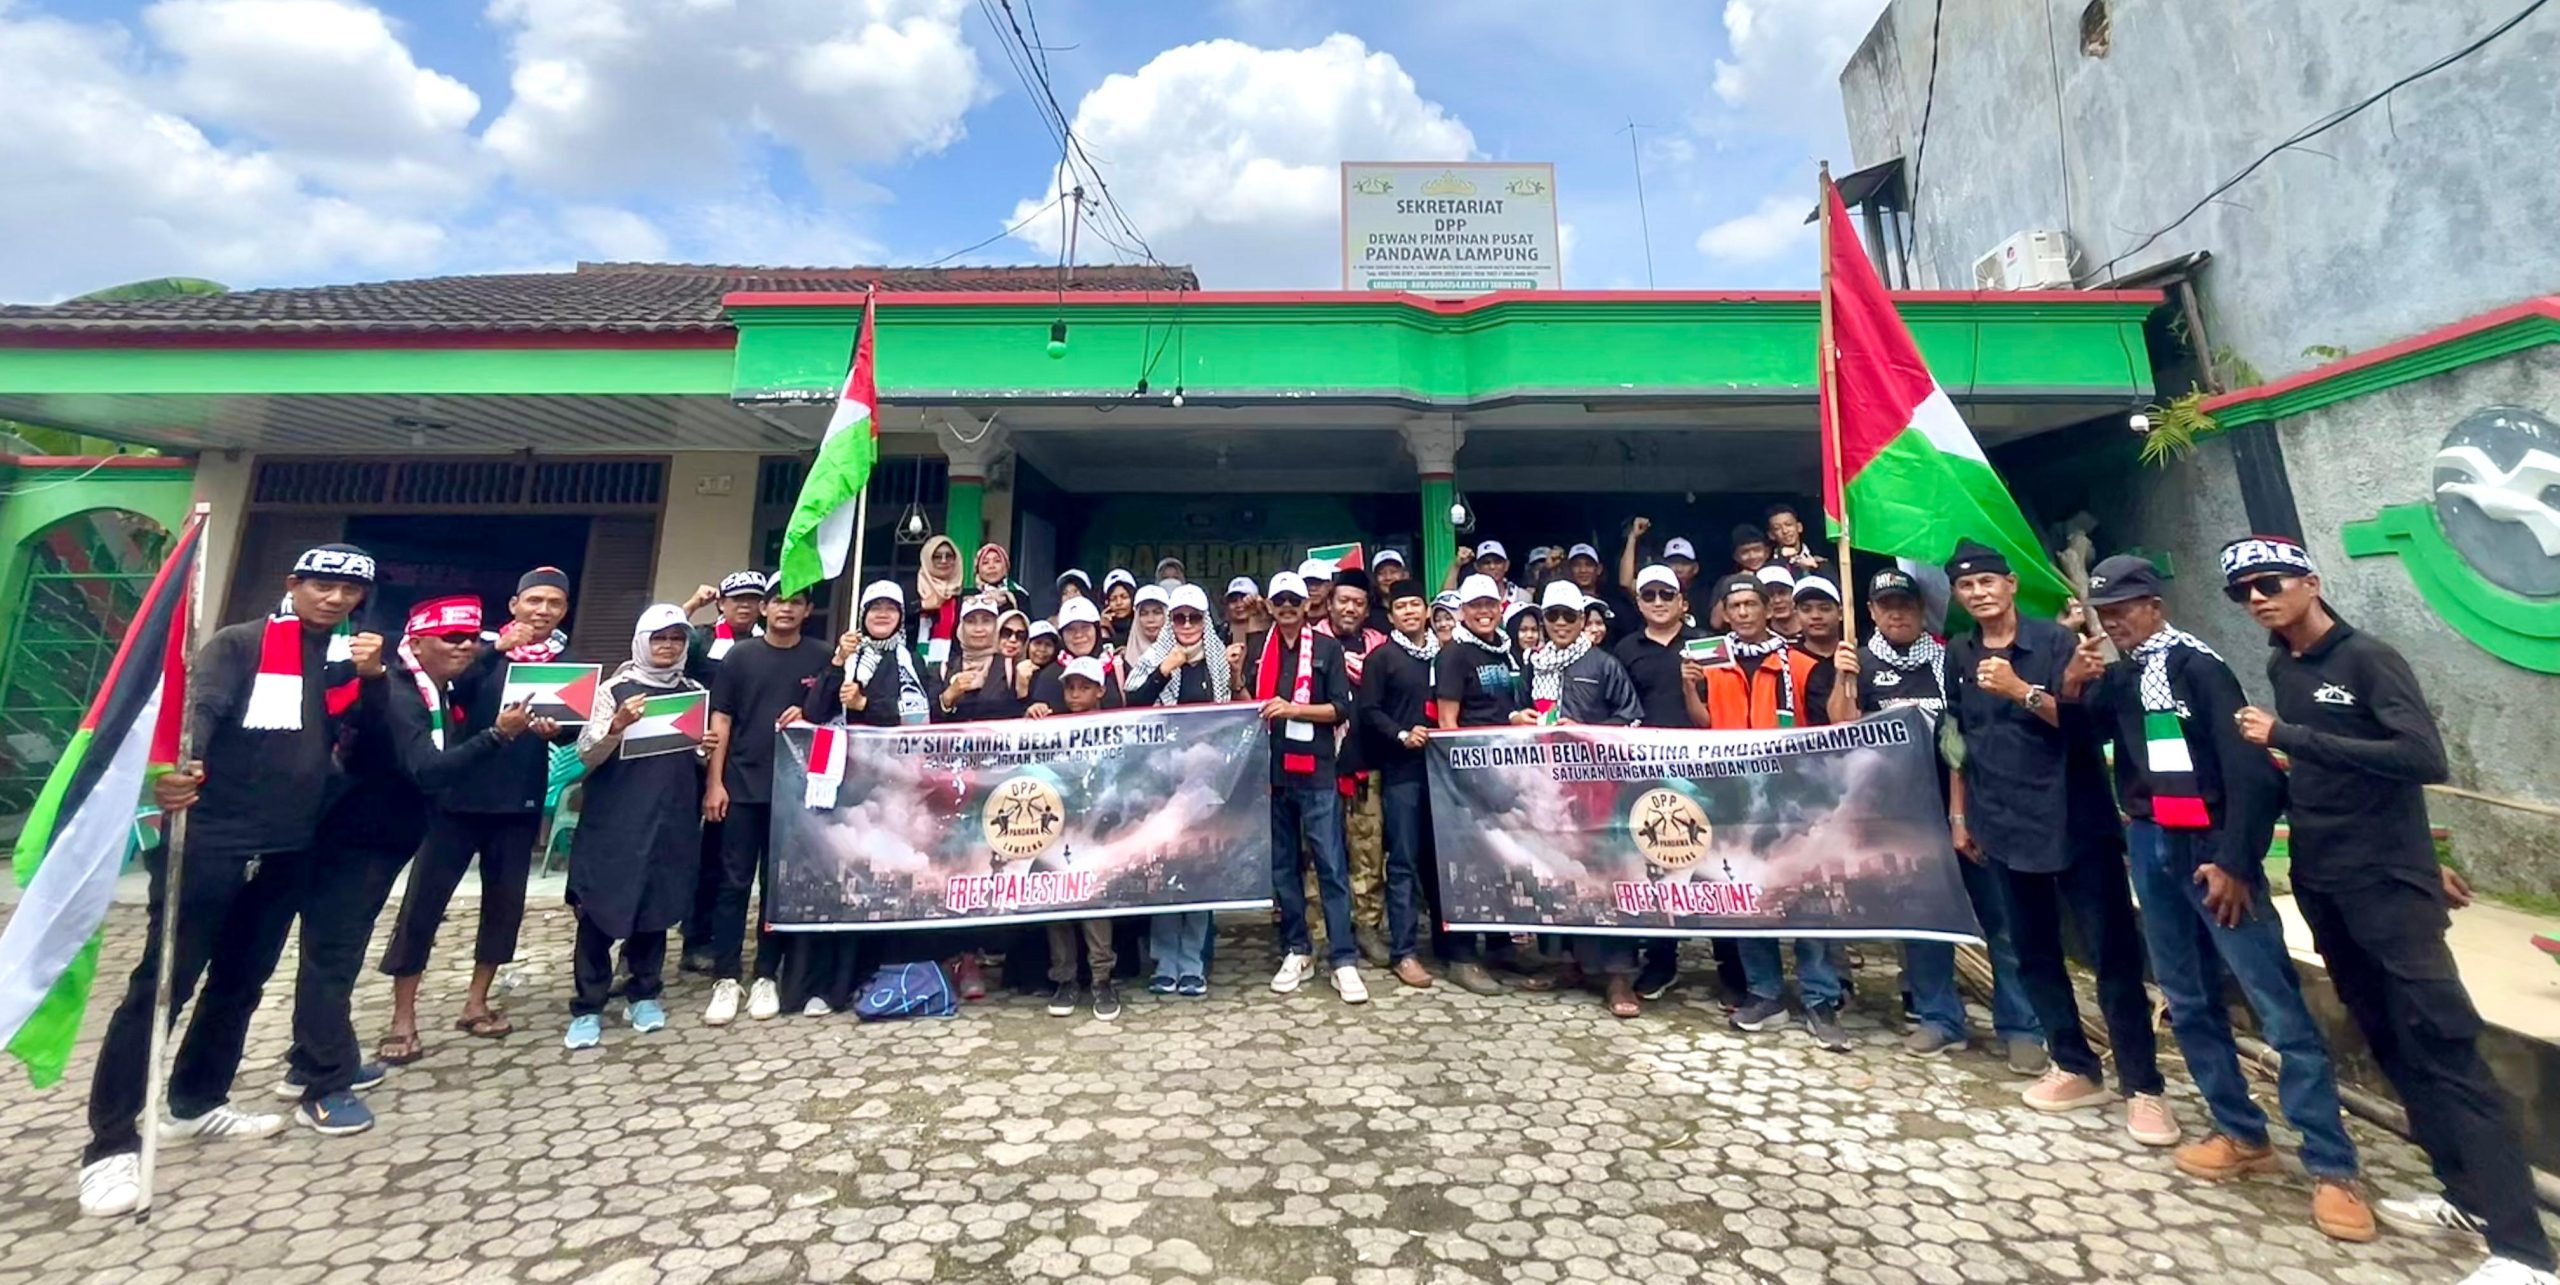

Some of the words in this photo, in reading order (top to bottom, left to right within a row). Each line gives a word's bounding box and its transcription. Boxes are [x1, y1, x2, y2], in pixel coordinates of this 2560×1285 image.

[1397, 199, 1504, 214] SEKRETARIAT
[1435, 218, 1467, 232] DPP
[1369, 233, 1418, 245] DEWAN
[1421, 233, 1489, 245] PIMPINAN
[1492, 233, 1534, 245] PUSAT
[1366, 247, 1452, 261] PANDAWA
[1456, 247, 1539, 261] LAMPUNG
[1452, 747, 1488, 767] AKSI
[1493, 745, 1546, 766] DAMAI
[1552, 743, 1591, 763] BELA
[1595, 743, 1690, 763] PALESTINA
[1698, 737, 1800, 759] PANDAWA
[1805, 721, 1908, 751] LAMPUNG
[1552, 764, 1607, 781] SATUKAN
[1717, 760, 1747, 775] DAN
[1751, 759, 1782, 773] DOA
[1011, 781, 1037, 797] DPP
[1651, 794, 1677, 808] DPP
[947, 876, 989, 911] FREE
[993, 871, 1092, 907] PALESTINE
[1614, 882, 1656, 914] FREE
[1656, 881, 1760, 914] PALESTINE
